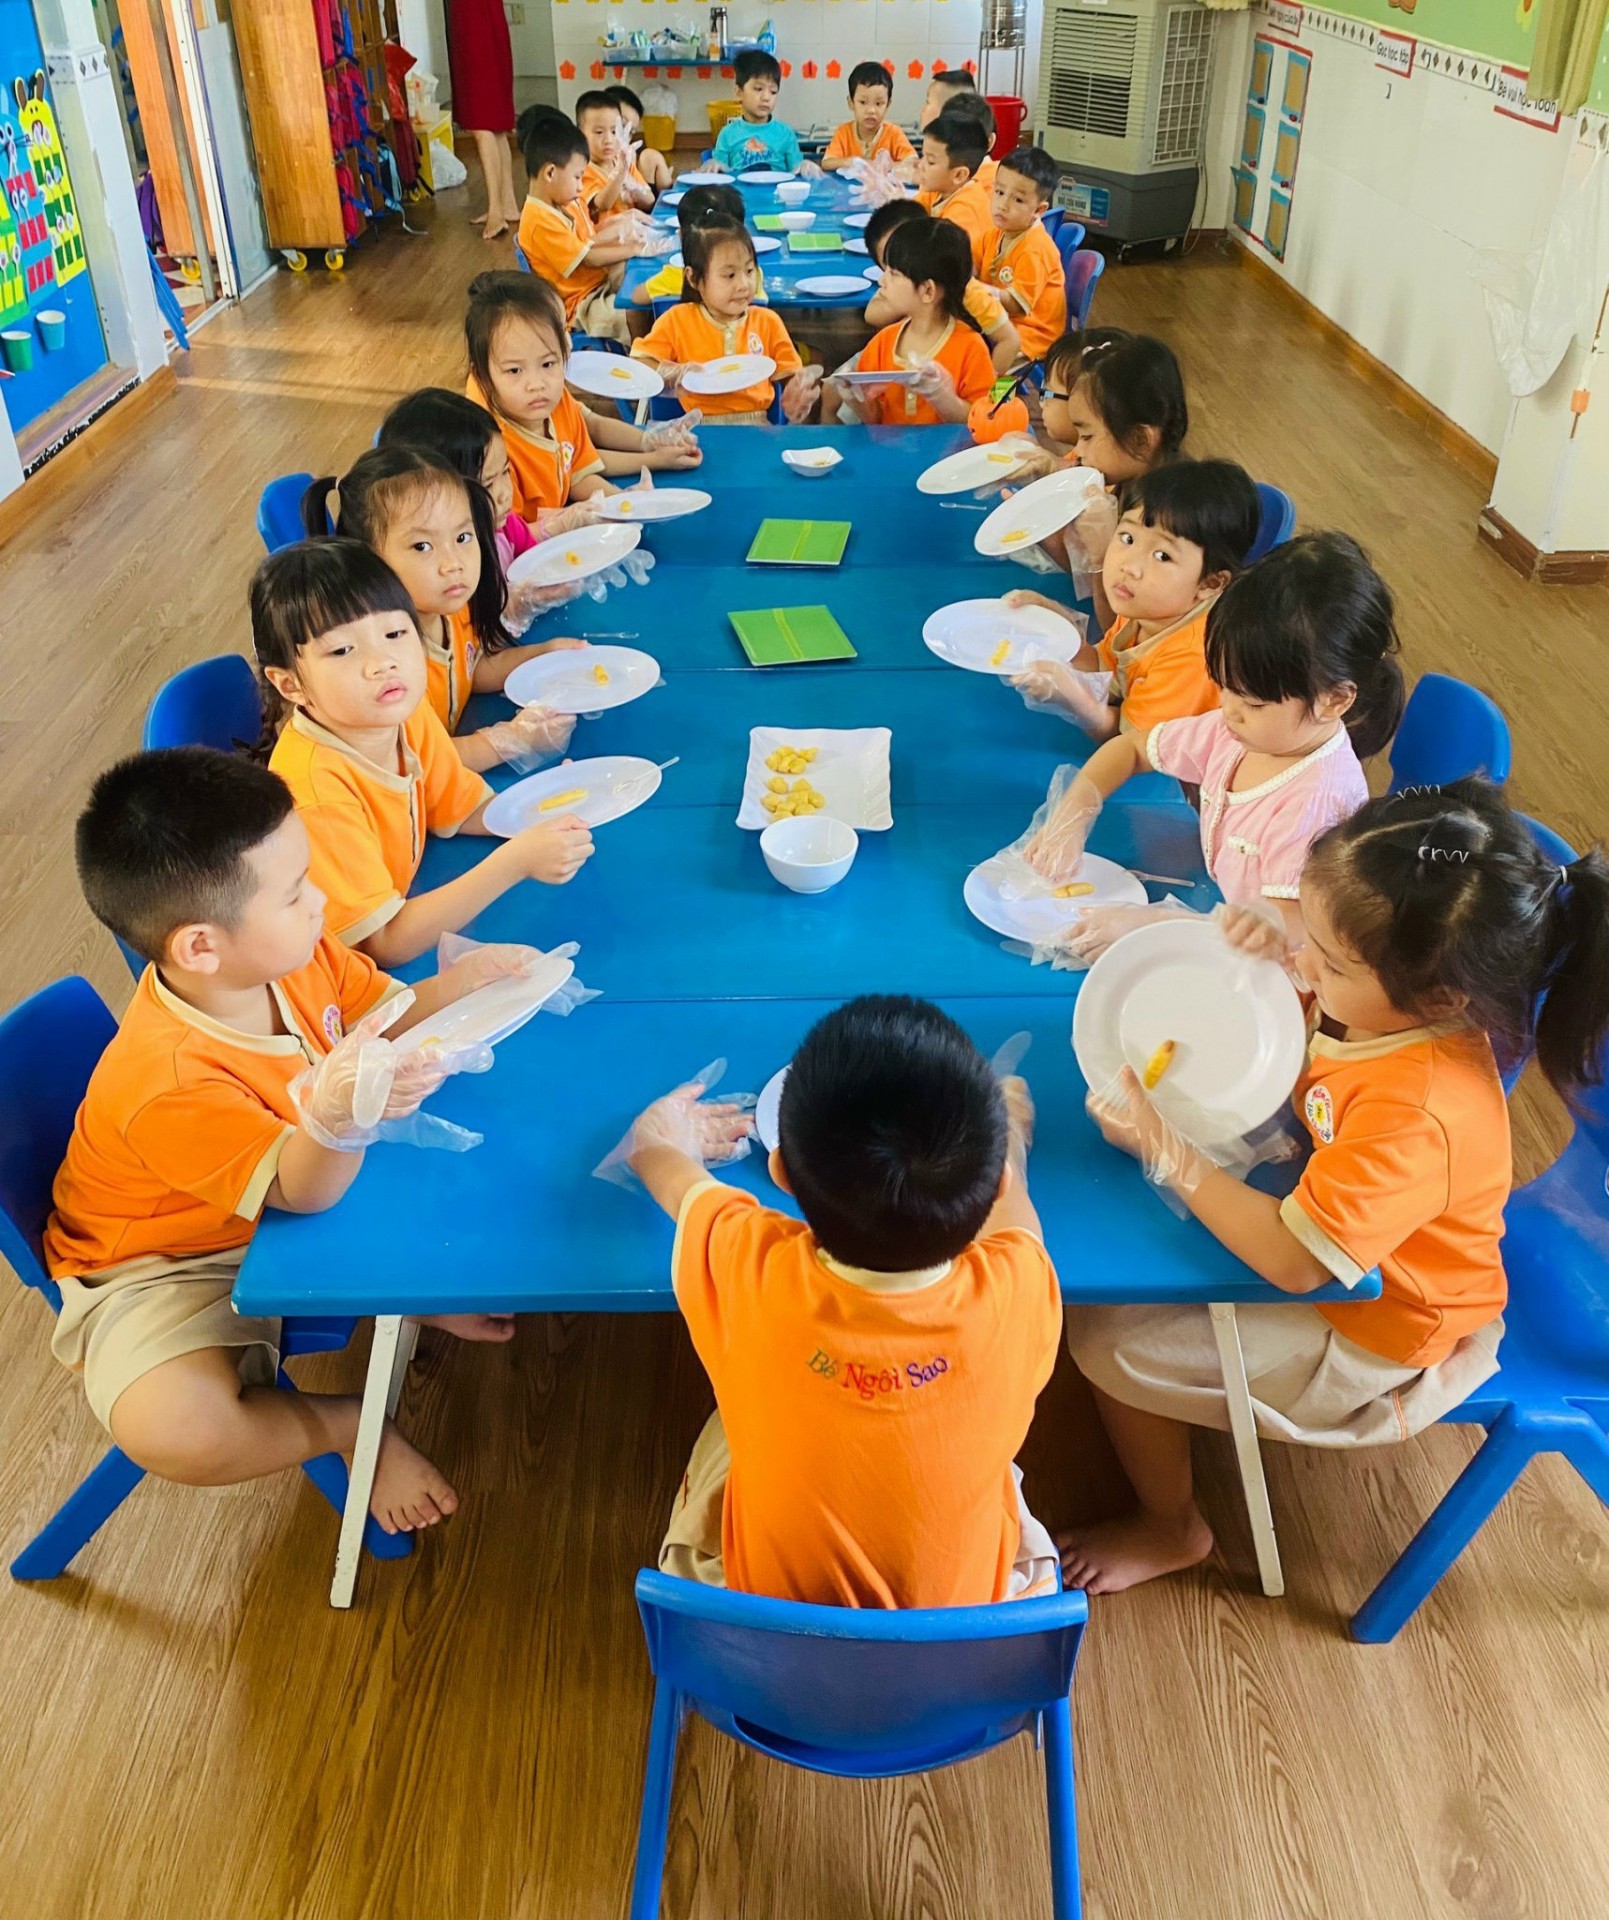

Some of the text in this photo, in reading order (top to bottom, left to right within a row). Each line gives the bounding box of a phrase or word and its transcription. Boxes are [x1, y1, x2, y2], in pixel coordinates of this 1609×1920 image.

[806, 1348, 949, 1400] Bé Ngôi Sao
